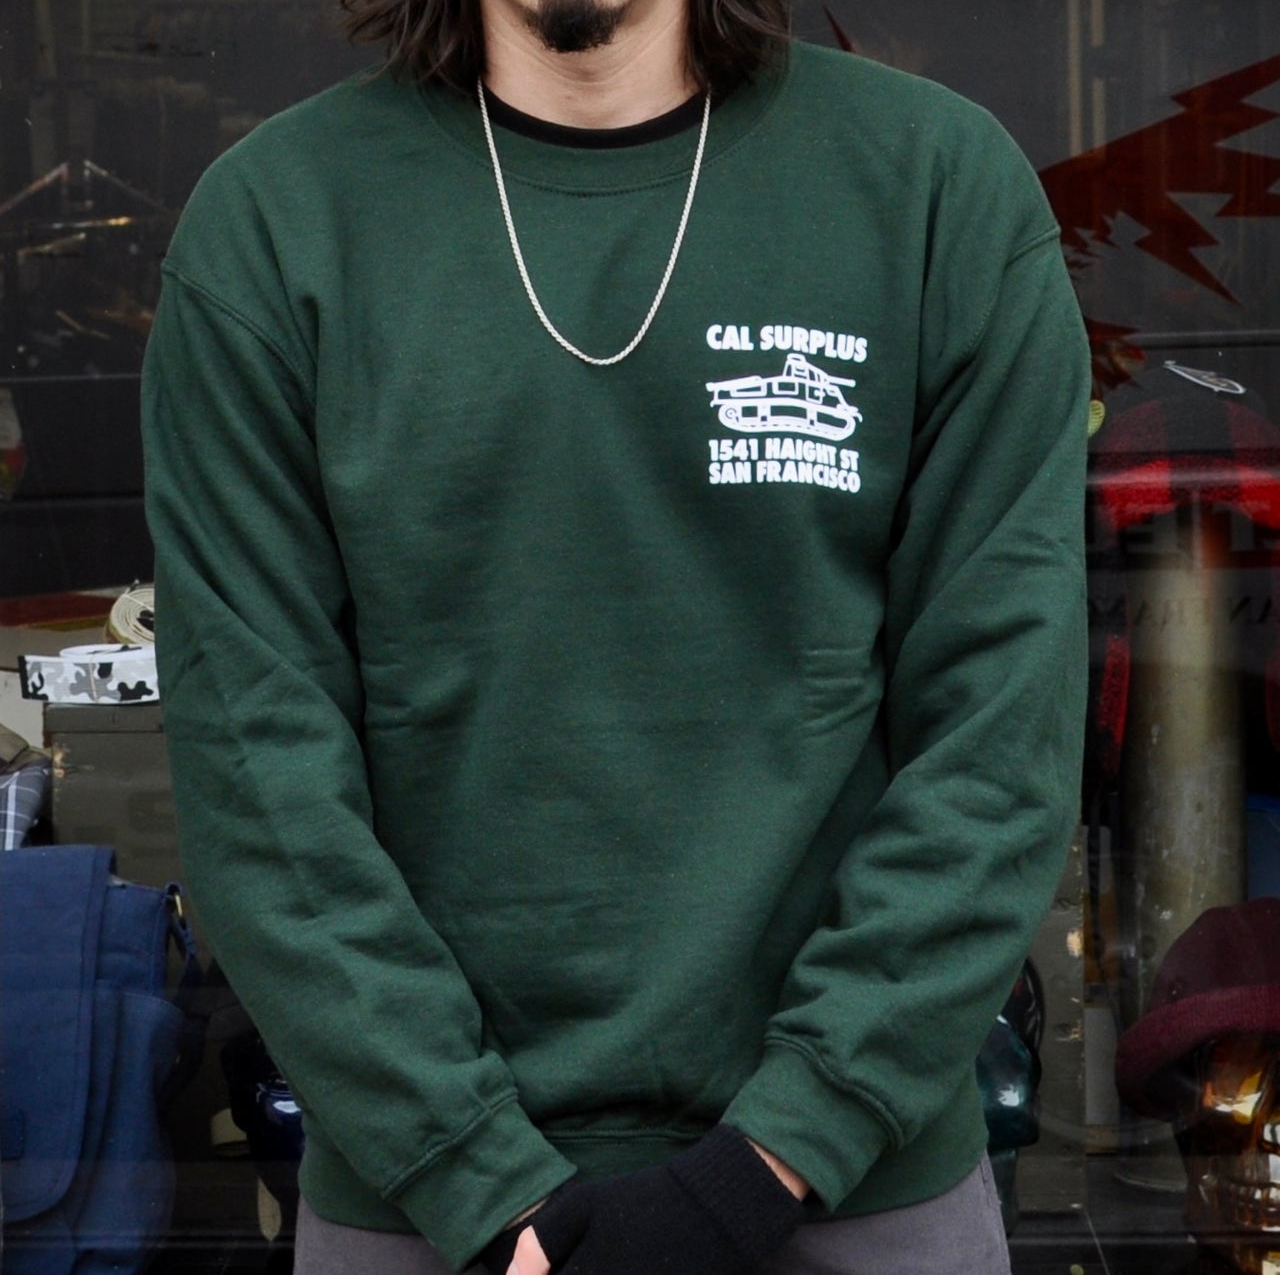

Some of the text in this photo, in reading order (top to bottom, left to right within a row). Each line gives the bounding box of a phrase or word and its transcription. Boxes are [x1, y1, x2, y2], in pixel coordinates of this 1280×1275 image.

[706, 325, 868, 363] CAL SURPLUS
[709, 438, 859, 471] 1541 HAIGHT ST
[709, 462, 861, 493] SAN FRANCISCO
